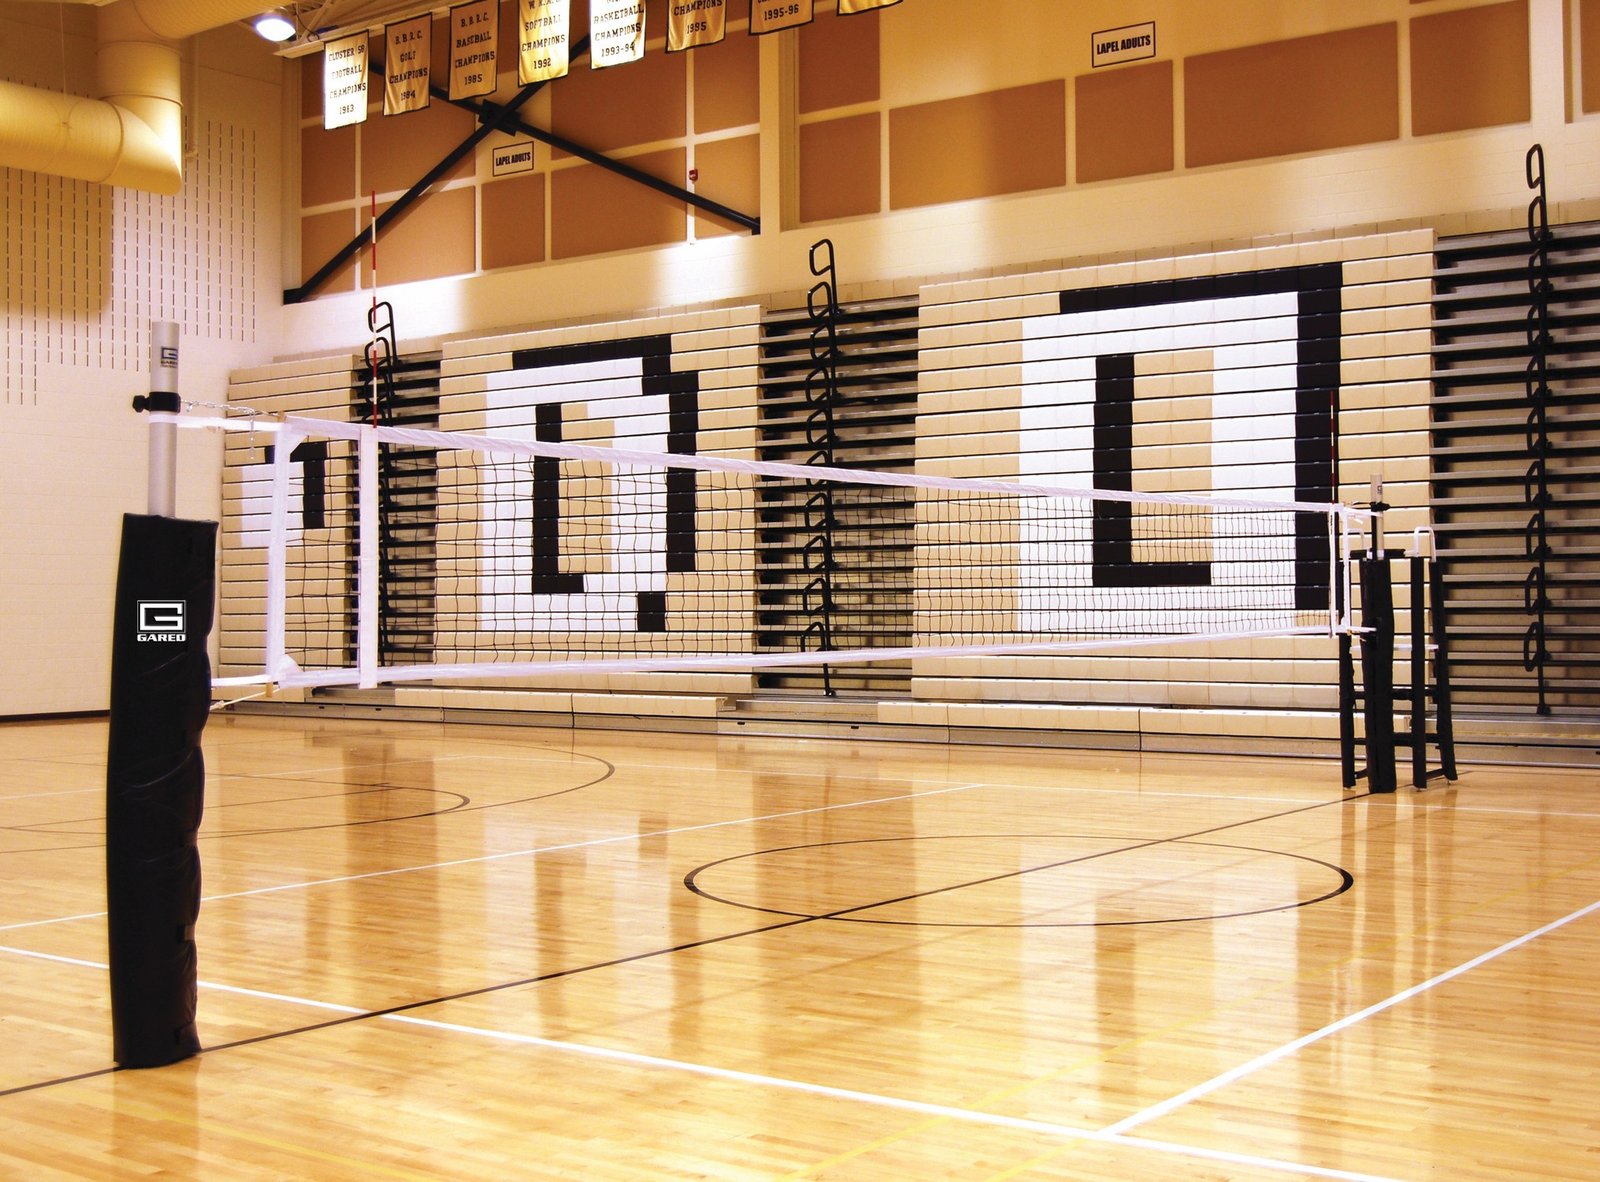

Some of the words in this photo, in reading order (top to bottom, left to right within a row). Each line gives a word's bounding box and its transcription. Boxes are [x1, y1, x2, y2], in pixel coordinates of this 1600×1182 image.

[593, 3, 645, 25] BASKETBALL
[673, 0, 723, 16] CHAMPIONS
[763, 3, 800, 21] 1995-96
[524, 14, 563, 32] SOFTBALL
[686, 21, 708, 35] 1995
[455, 31, 493, 49] BASEBALL
[594, 22, 642, 42] CHAMPIONS
[521, 34, 566, 52] CHAMPIONS
[601, 41, 636, 58] 1993-94
[1096, 41, 1120, 55] LAPEL
[1120, 34, 1152, 51] ADULTS
[328, 47, 355, 62] CLUSTER
[400, 50, 417, 63] GOLF
[455, 50, 496, 69] CHAMPIONS
[331, 64, 363, 80] FOOTBALL
[533, 57, 552, 70] 1992
[389, 67, 428, 84] CHAMPIONS
[464, 73, 483, 86] 1985
[329, 82, 367, 99] CHAMPIONS
[495, 155, 511, 167] LAPEL
[511, 151, 531, 164] ADULTS
[136, 633, 187, 642] GARED
